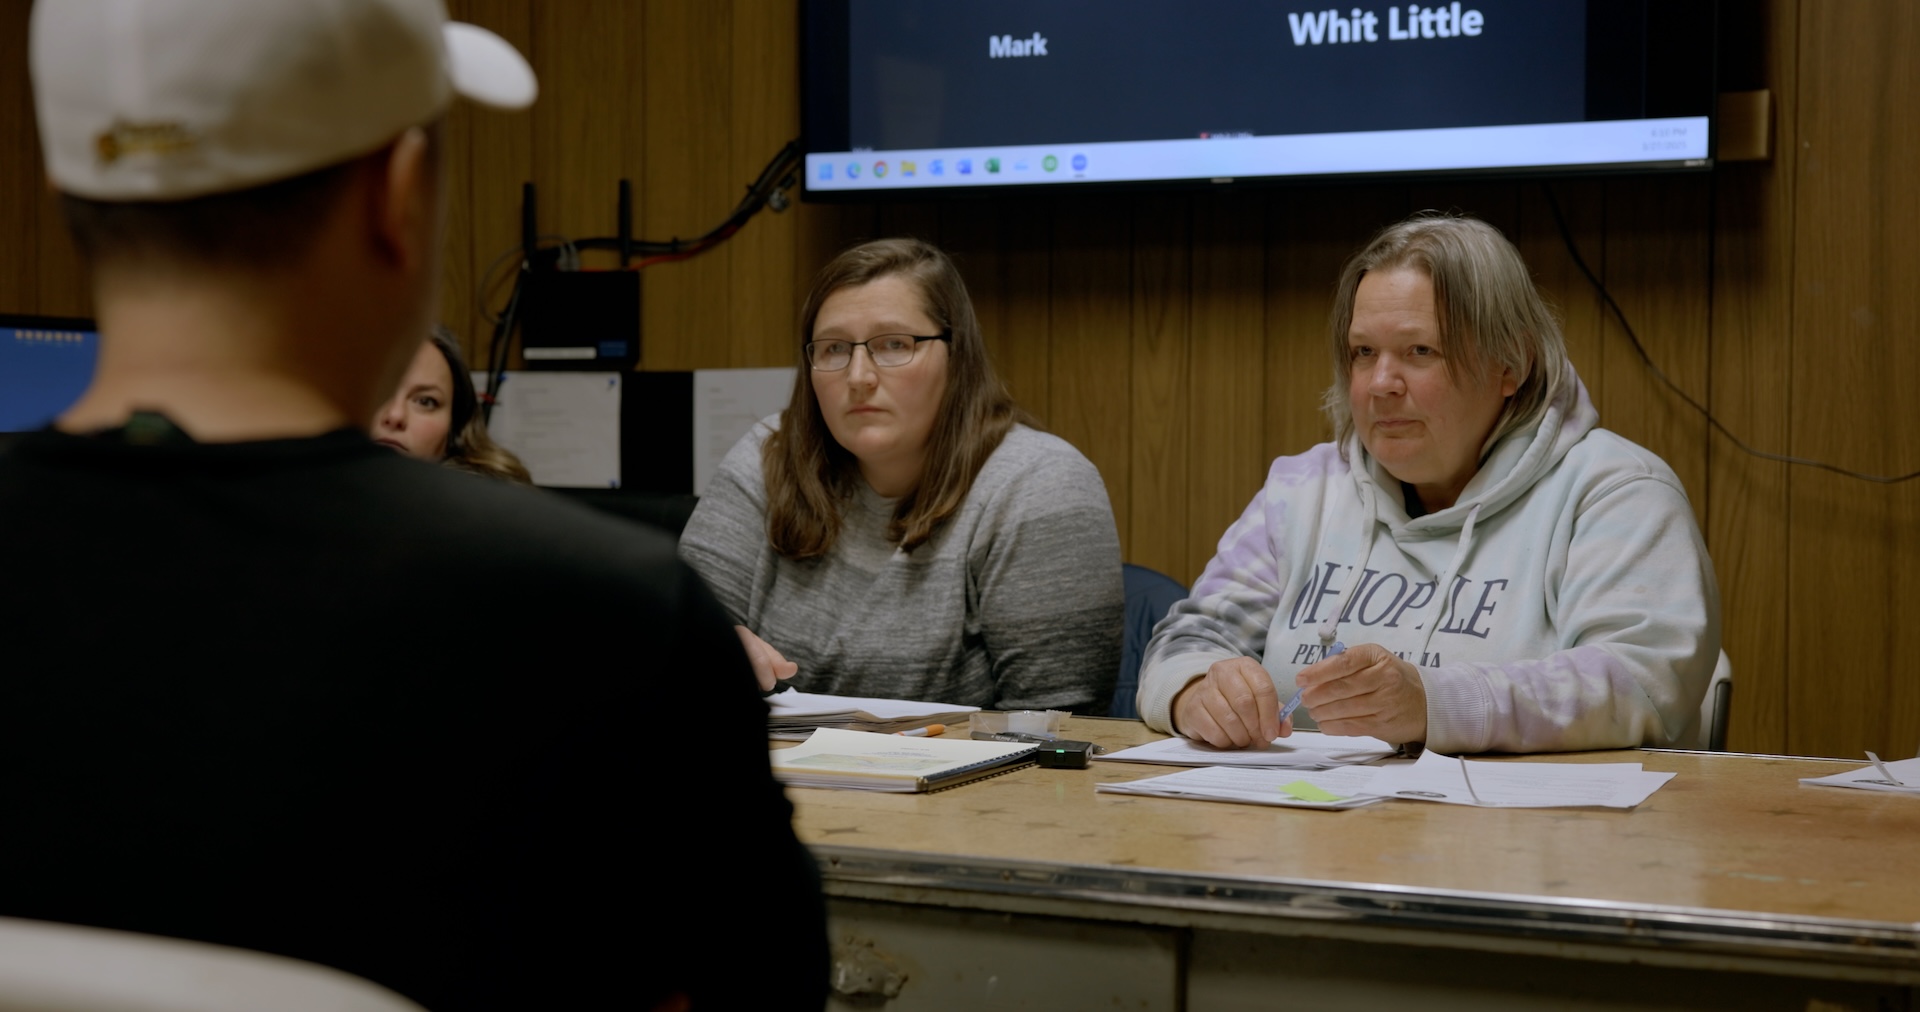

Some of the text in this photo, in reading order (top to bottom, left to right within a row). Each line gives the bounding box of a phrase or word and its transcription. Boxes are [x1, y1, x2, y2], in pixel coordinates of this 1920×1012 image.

[988, 31, 1048, 59] Mark
[1288, 1, 1485, 46] Whit Little
[1288, 561, 1509, 639] OHIOPLE
